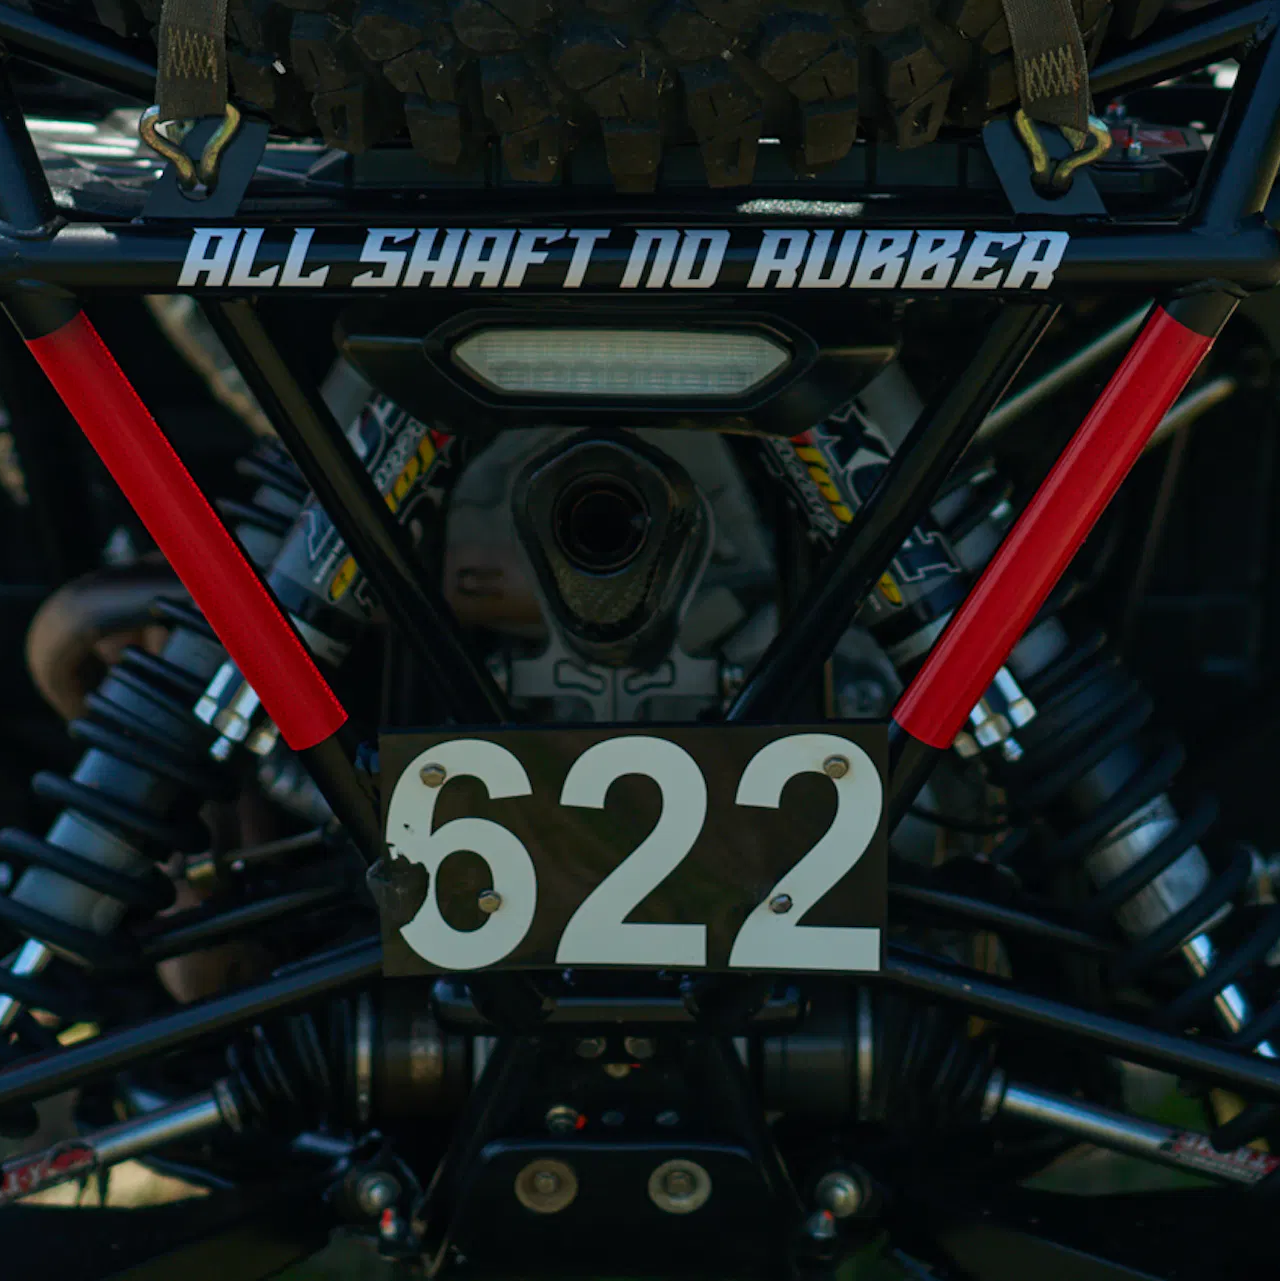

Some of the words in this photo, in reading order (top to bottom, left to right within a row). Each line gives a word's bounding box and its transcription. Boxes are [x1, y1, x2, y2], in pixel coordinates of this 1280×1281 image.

[177, 227, 329, 286] ALL
[352, 228, 610, 287] SHAFT
[619, 228, 727, 288] NO
[747, 230, 1071, 289] RUBBER
[385, 732, 884, 972] 622
